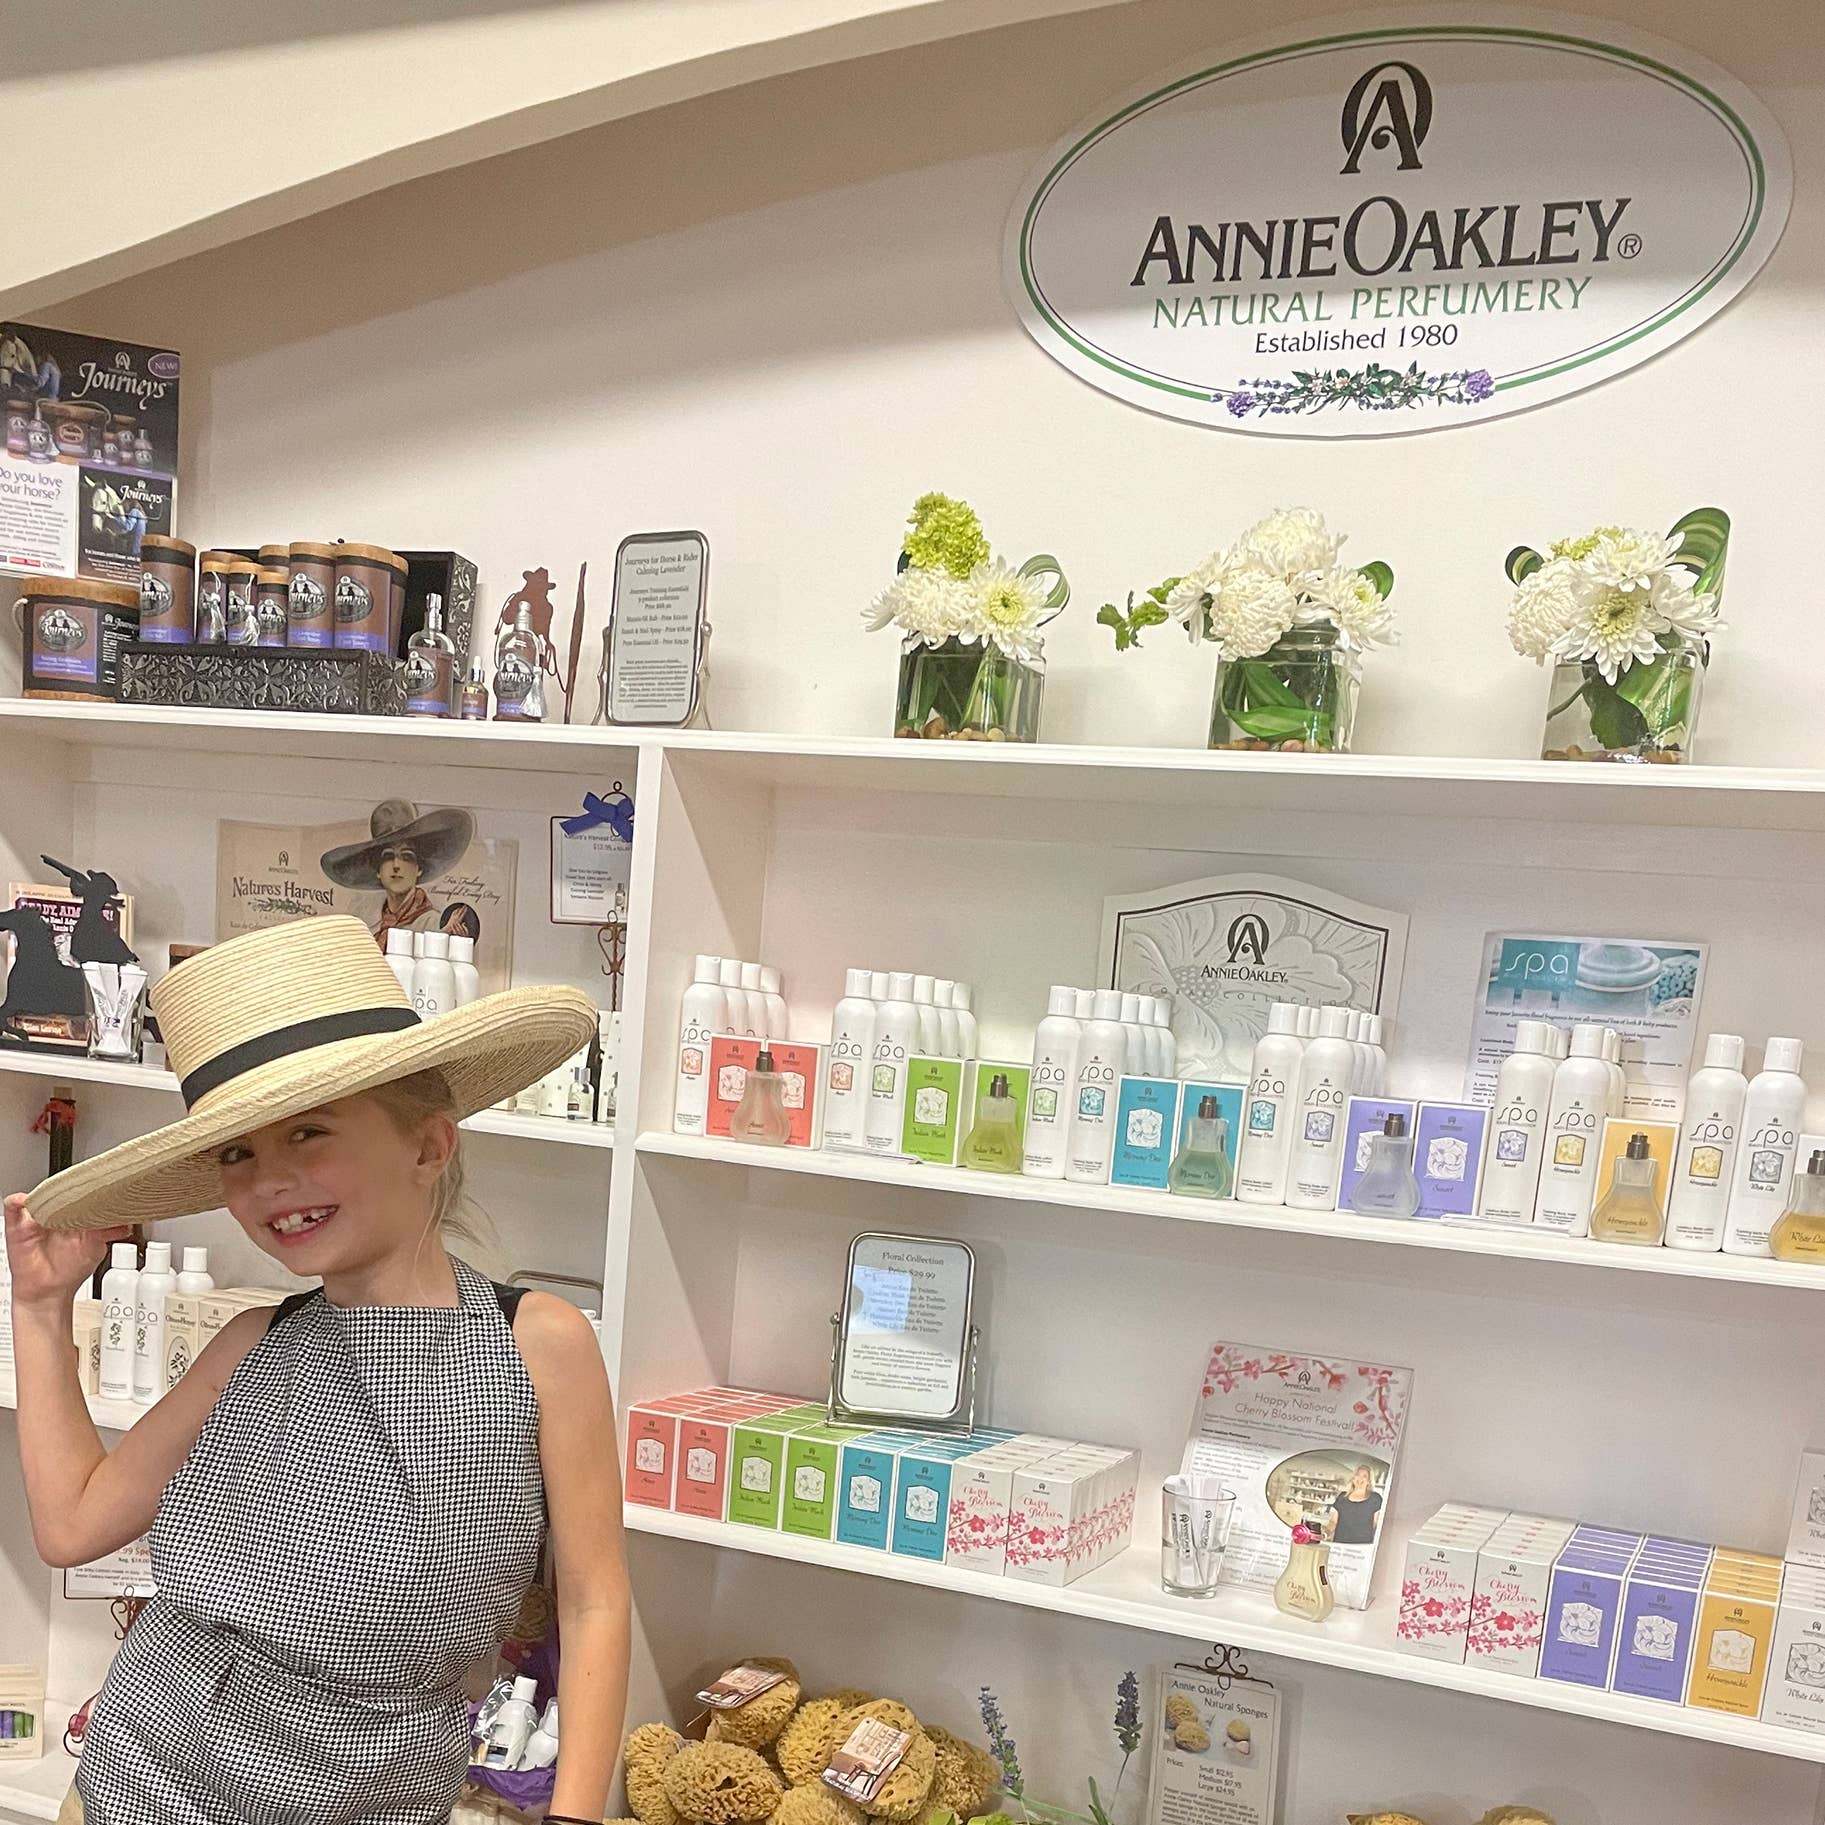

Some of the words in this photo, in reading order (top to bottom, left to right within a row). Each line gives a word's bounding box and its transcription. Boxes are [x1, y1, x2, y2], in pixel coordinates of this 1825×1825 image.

[1152, 287, 1332, 329] NATURAL
[1350, 276, 1593, 321] PERFUMERY
[1255, 326, 1386, 355] Established
[1397, 325, 1459, 351] 1980
[71, 362, 167, 410] Journeys
[13, 472, 35, 484] you
[38, 473, 63, 488] love
[24, 484, 61, 500] horse?
[120, 485, 165, 509] Journeys
[232, 876, 283, 899] Natures
[284, 880, 335, 906] Harvest
[1505, 952, 1569, 980] spa
[831, 1042, 862, 1061] spa
[872, 1044, 905, 1063] spa
[1033, 1066, 1066, 1083] spa
[1080, 1065, 1114, 1083] spa
[1251, 1079, 1285, 1097] spa
[1304, 1088, 1344, 1107] spa
[1498, 1107, 1538, 1125] spa
[1554, 1112, 1596, 1132] spa
[1690, 1123, 1734, 1142] spa
[1749, 1129, 1794, 1148] spa
[881, 1252, 904, 1262] Floral
[905, 1254, 944, 1266] Collection
[1254, 1392, 1289, 1408] Happy
[1292, 1399, 1337, 1415] National
[1234, 1403, 1269, 1418] Cherry
[1271, 1409, 1312, 1424] Blossom
[1418, 1564, 1448, 1581] Cherry
[1425, 1574, 1465, 1591] Blossom
[1489, 1578, 1521, 1594] Cherry
[1497, 1588, 1537, 1604] Blossom
[1171, 1680, 1196, 1692] Annie
[1197, 1684, 1225, 1699] Oakley
[1786, 1687, 1808, 1700] White
[1204, 1698, 1234, 1712] Natural
[1236, 1704, 1269, 1719] Sponges
